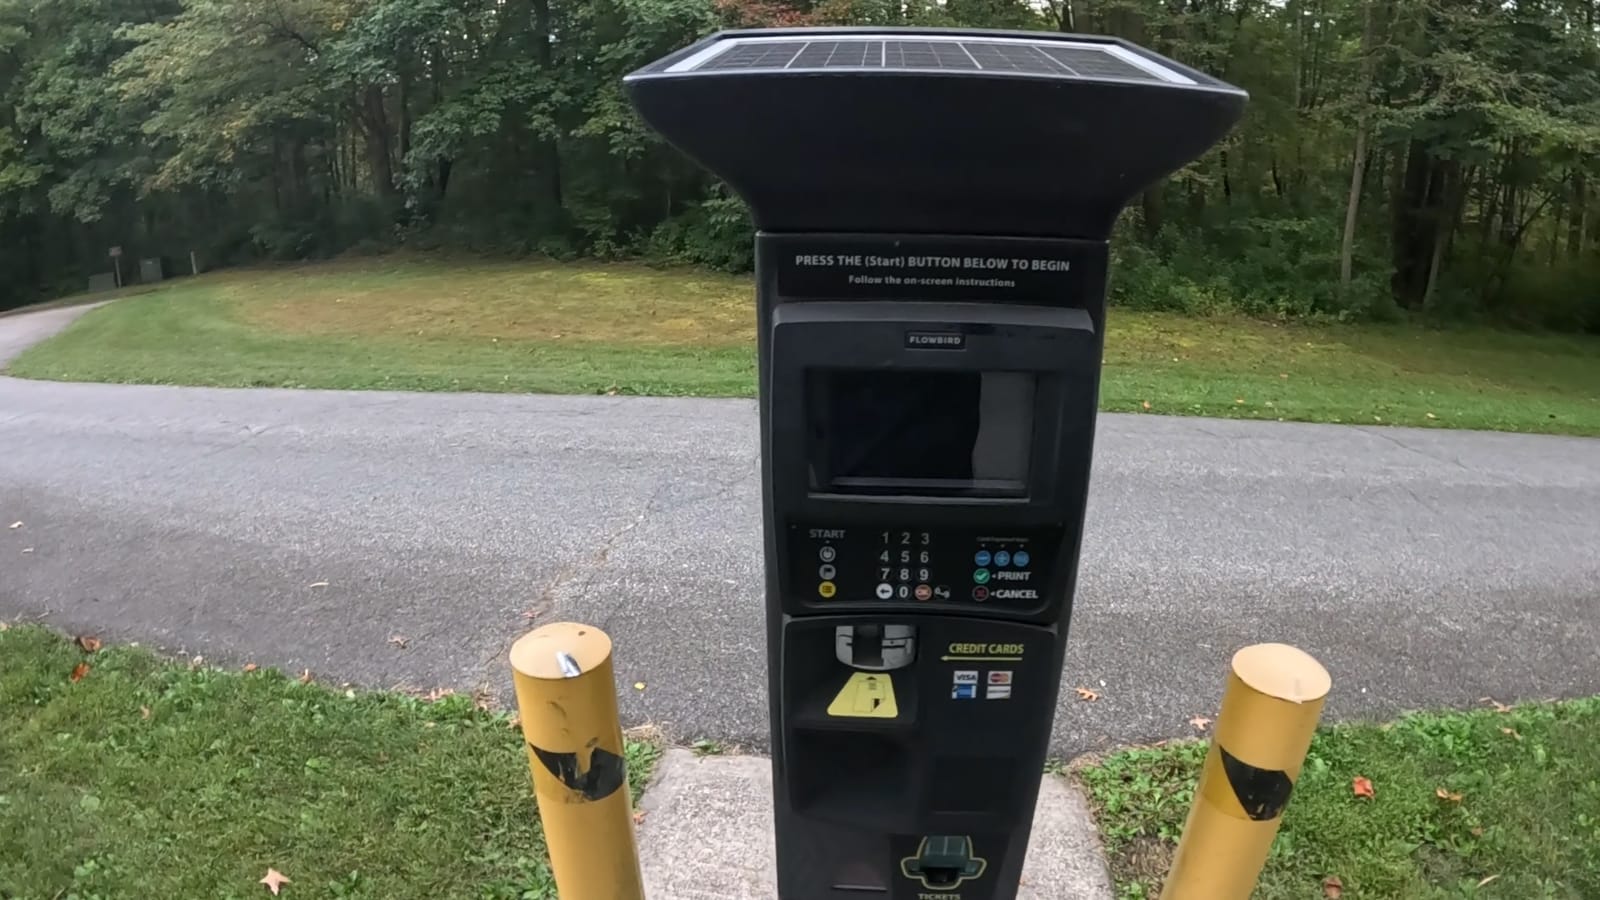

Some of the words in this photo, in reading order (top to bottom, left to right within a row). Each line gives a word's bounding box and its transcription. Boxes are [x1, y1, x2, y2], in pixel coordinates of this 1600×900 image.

[795, 254, 834, 266] PRESS
[836, 254, 862, 267] THE
[865, 255, 905, 268] (Start)
[908, 256, 960, 268] BUTTON
[963, 257, 1008, 270] BELOW
[1011, 258, 1029, 270] TO
[1031, 259, 1070, 271] BEGIN
[848, 274, 882, 285] Follow
[885, 275, 902, 285] the
[903, 276, 954, 287] on-screen
[955, 277, 1016, 288] instructions
[909, 335, 961, 345] FLOWBIRD
[809, 529, 846, 539] START
[882, 532, 889, 544] 1
[902, 532, 911, 544] 2
[921, 532, 930, 545] 3
[880, 550, 889, 562] 4
[901, 551, 910, 562] 5
[920, 551, 929, 563] 6
[881, 568, 890, 580] 7
[900, 568, 909, 580] 8
[920, 568, 929, 580] 9
[997, 571, 1032, 581] PRINT
[899, 586, 908, 598] 0
[996, 589, 1039, 599] CANCEL
[949, 643, 987, 654] CREDIT
[988, 643, 1025, 655] CARDS
